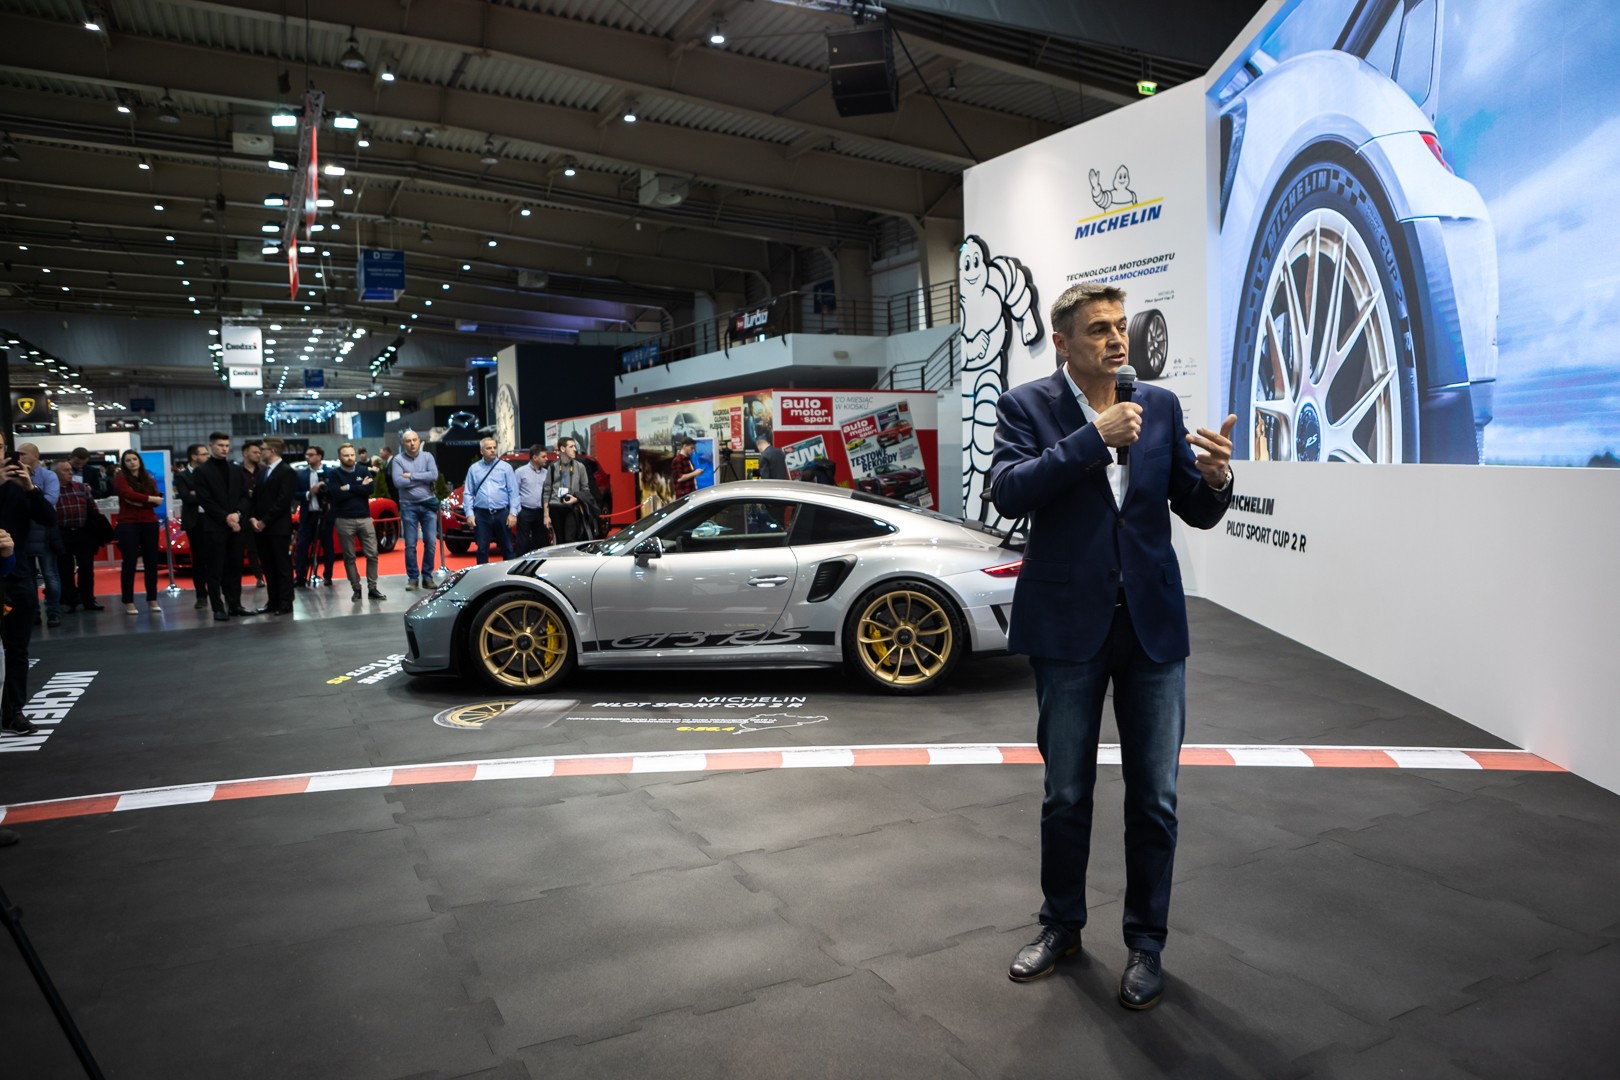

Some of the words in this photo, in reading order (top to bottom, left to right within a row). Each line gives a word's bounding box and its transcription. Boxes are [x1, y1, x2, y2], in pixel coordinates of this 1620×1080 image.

[1074, 204, 1162, 240] MICHELIN
[1267, 170, 1329, 253] MICHELIN
[1066, 265, 1117, 281] TECHNOLOGIA
[1118, 252, 1176, 271] MOTOSPORTU
[1109, 264, 1169, 283] SAMOCHODZIE
[1379, 235, 1398, 282] CUP
[1395, 288, 1403, 305] 2
[742, 309, 769, 329] turbo
[782, 398, 821, 409] auto
[790, 408, 828, 417] motor
[804, 415, 832, 424] sport
[843, 420, 869, 434] auto
[850, 424, 874, 437] motor
[850, 447, 887, 468] TESTOWE
[861, 452, 898, 473] REKORDY
[1227, 520, 1246, 538] PILOT
[1246, 524, 1271, 544] SPORT
[1272, 529, 1290, 548] CUP
[1291, 533, 1298, 550] 2
[1299, 534, 1307, 552] R
[611, 631, 704, 648] GT3
[716, 626, 809, 646] RS
